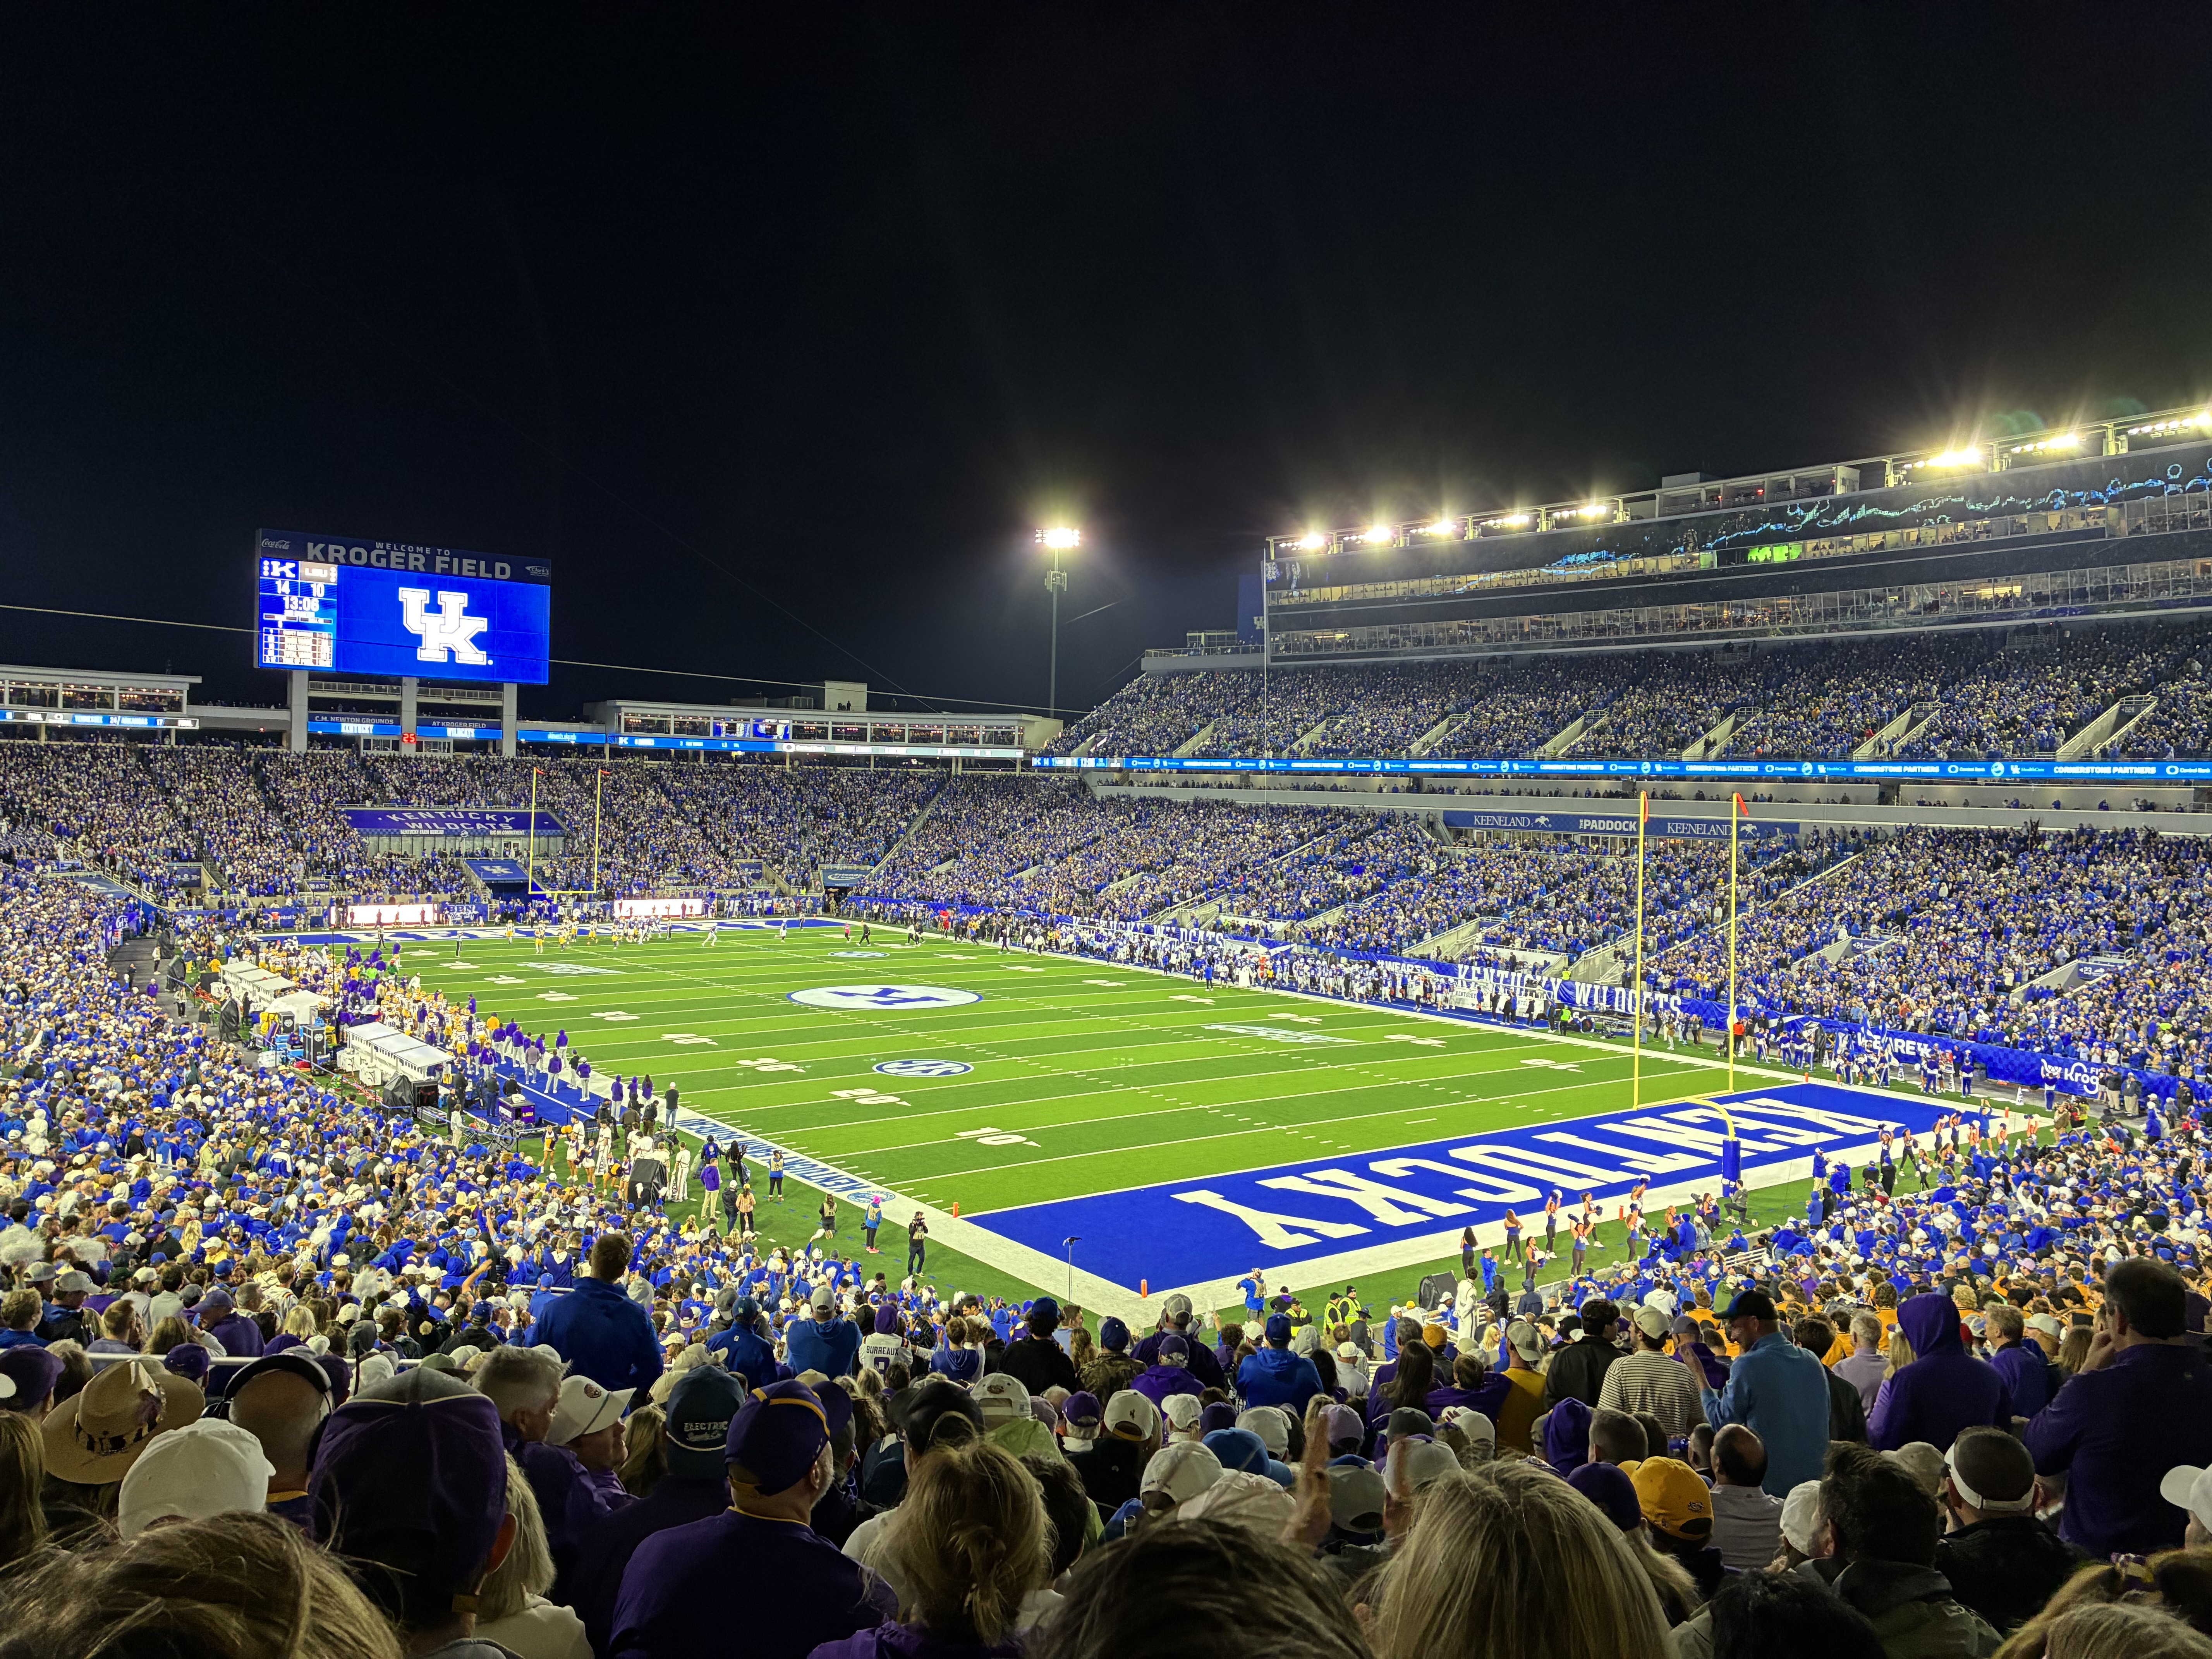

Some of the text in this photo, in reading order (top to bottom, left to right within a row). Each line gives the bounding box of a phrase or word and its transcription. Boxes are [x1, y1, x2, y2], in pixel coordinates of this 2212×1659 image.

[375, 542, 431, 554] WELCOME
[307, 542, 511, 579] KROGER FIELD
[271, 561, 295, 578] K
[305, 567, 328, 577] LSU
[275, 580, 290, 594] 14
[311, 583, 325, 598] 10
[283, 596, 319, 612] 13:06
[403, 733, 416, 743] 25
[2054, 766, 2156, 775] CORNERSTONE PARTNERS
[386, 812, 516, 823] KENTUCKY
[1474, 815, 1530, 827] KEENELAND
[1583, 819, 1637, 831] PADDOCK
[1667, 823, 1733, 836] KEENELAND
[2084, 967, 2092, 975] 23
[1458, 963, 1563, 1001] KENTUCKY
[828, 1088, 901, 1105] 20
[954, 1127, 1027, 1146] 10
[1170, 1098, 1907, 1249] KENTUCKY
[866, 1346, 899, 1356] BURREAUX
[684, 1421, 728, 1432] ELECTRIC
